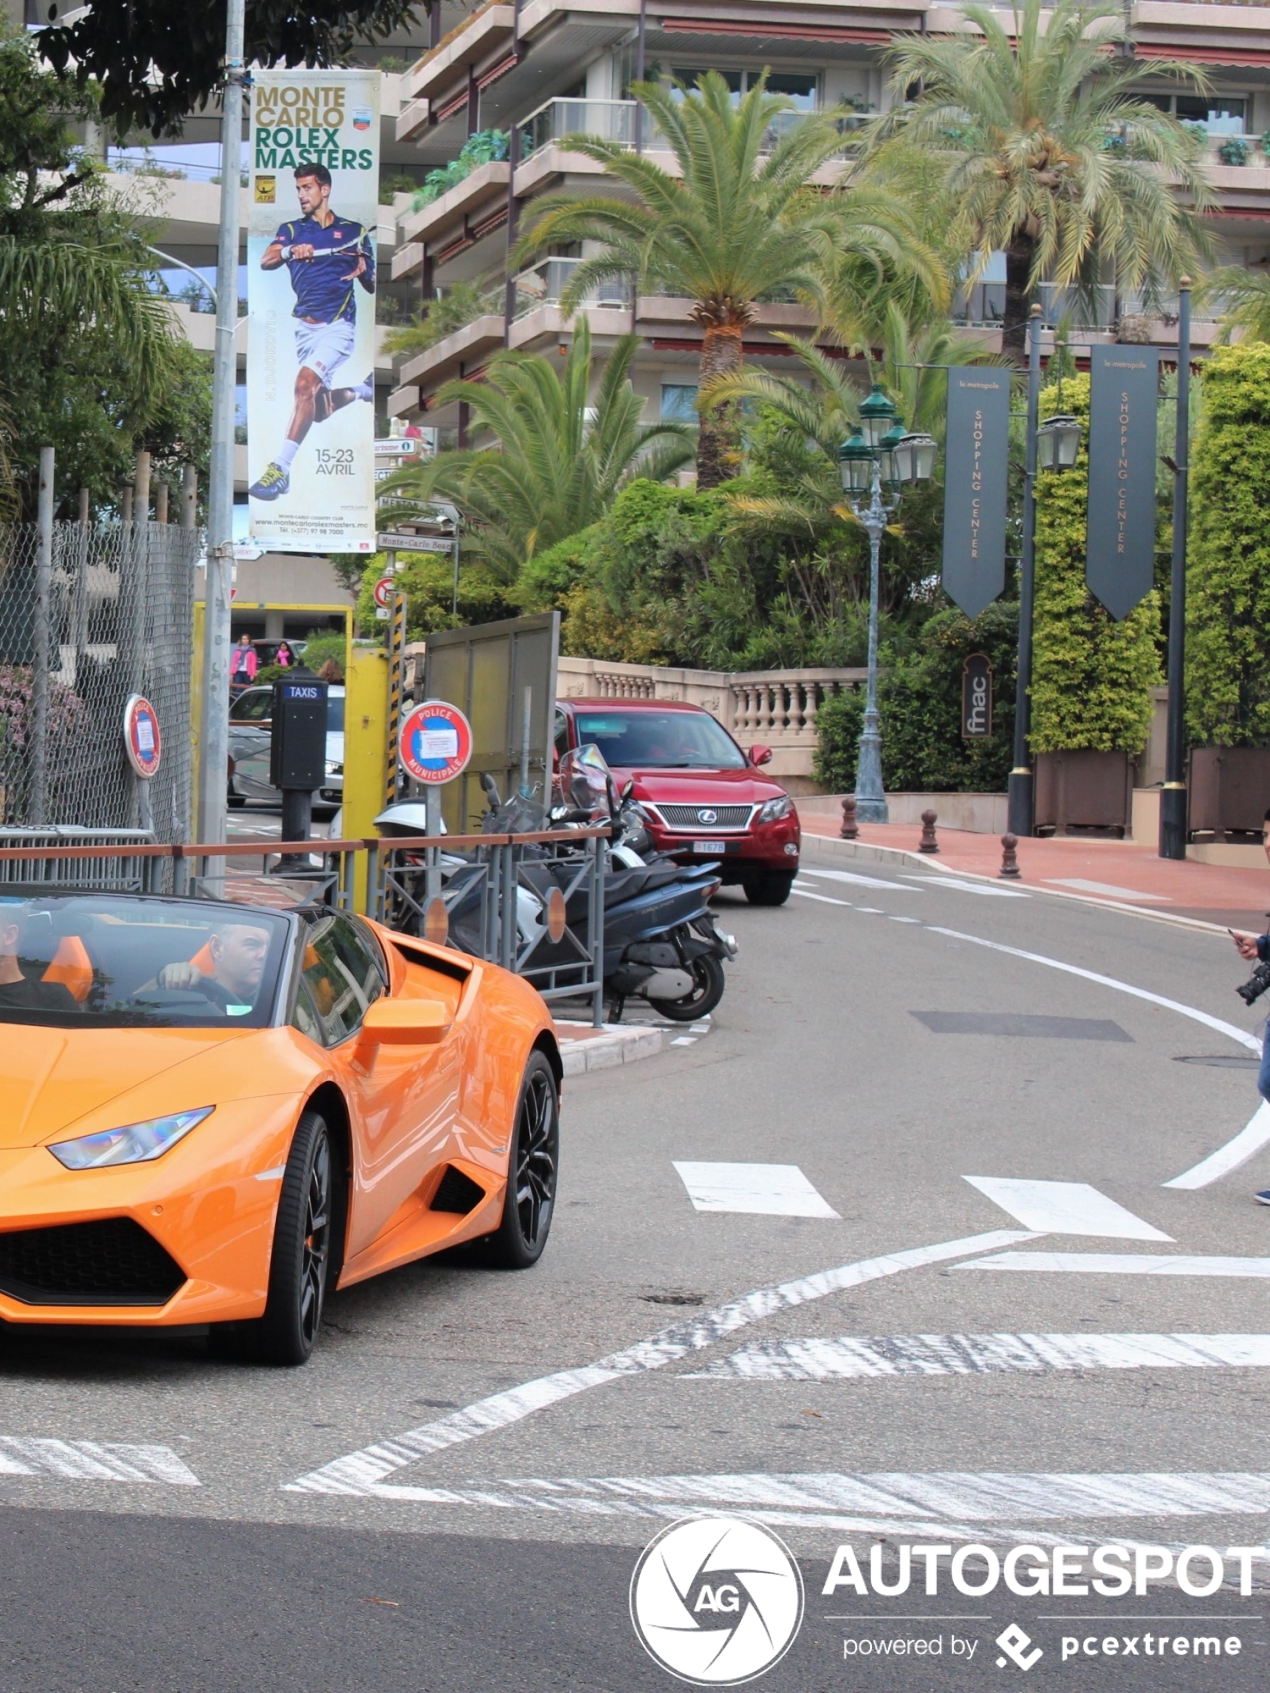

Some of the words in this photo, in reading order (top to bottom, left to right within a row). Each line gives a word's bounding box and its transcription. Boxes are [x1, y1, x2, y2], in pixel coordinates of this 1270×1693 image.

[256, 86, 346, 107] MONTE
[255, 106, 345, 128] CARLO
[256, 127, 340, 149] ROLEX
[255, 148, 373, 170] MASTERS
[264, 309, 276, 385] DJOKOVIC
[1118, 392, 1129, 481] SHOPPING
[315, 449, 355, 463] 15-23
[972, 410, 983, 492] SHOPPING
[315, 464, 356, 476] AVRIL
[971, 499, 980, 559] CENTER
[1117, 488, 1127, 554] CENTER
[382, 536, 430, 549] Monte-Carlo
[432, 541, 452, 550] Beac
[290, 686, 318, 699] TAXIS
[418, 708, 453, 721] POLICE
[967, 676, 987, 733] fnac
[408, 758, 463, 780] MUNICIPALE
[703, 843, 724, 852] 1678
